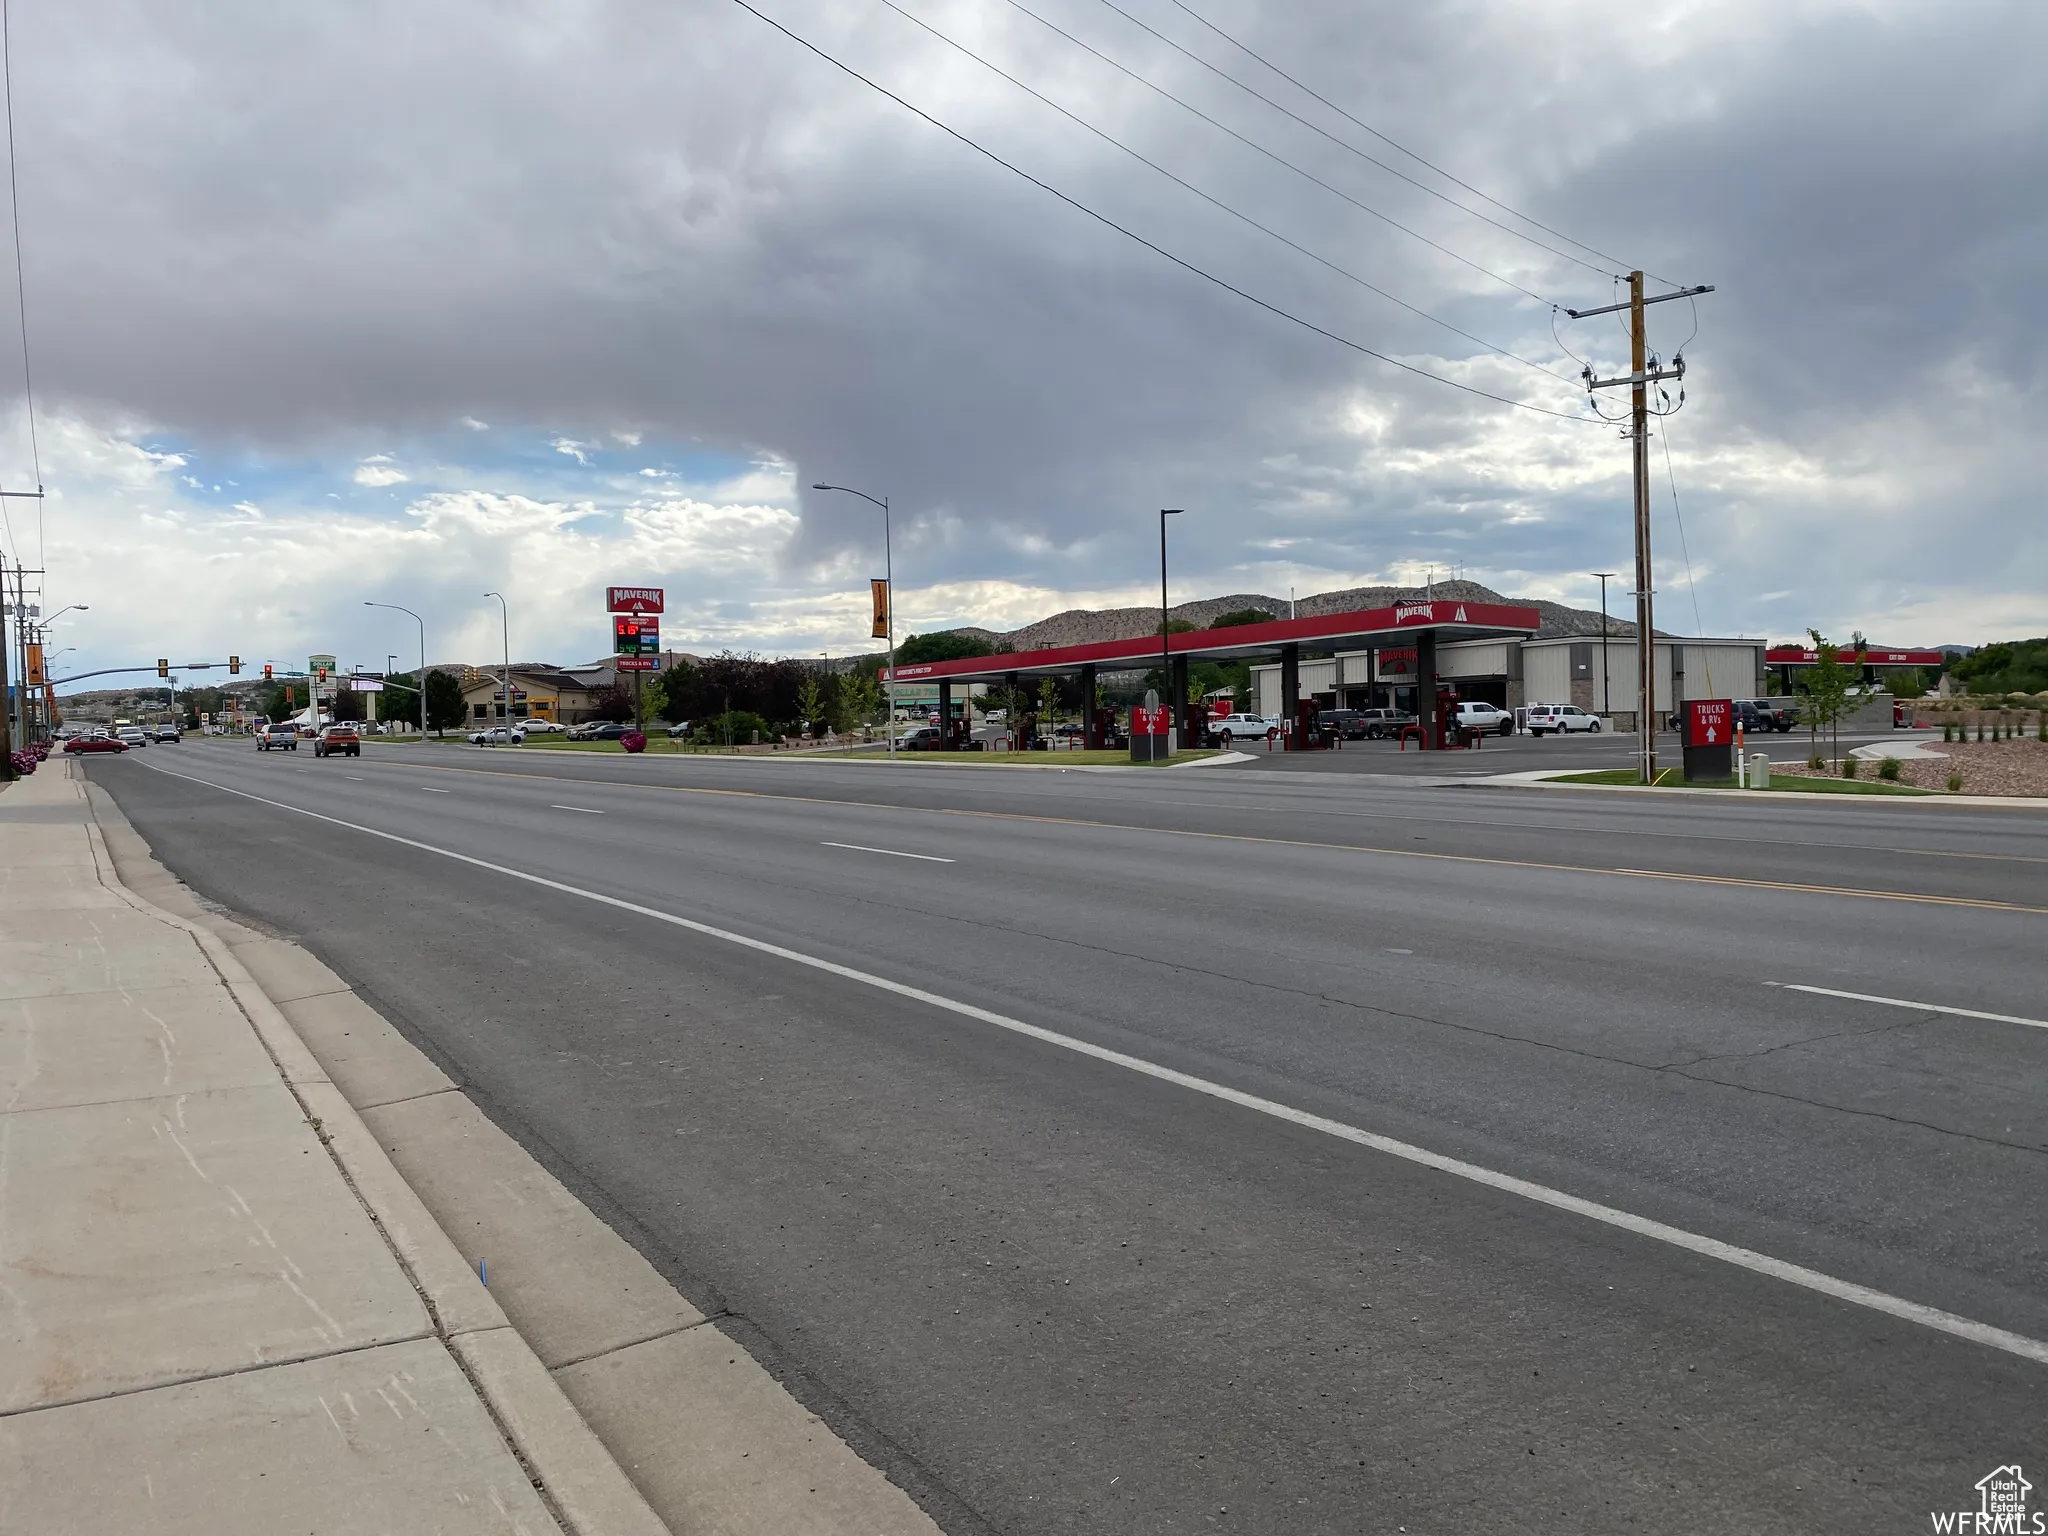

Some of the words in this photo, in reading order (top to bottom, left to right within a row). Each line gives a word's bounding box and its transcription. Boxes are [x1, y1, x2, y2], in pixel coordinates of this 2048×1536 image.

[614, 590, 660, 606] MAVERIK
[1396, 604, 1432, 624] MAVERIK
[1380, 648, 1418, 667] MAVERIK
[1697, 704, 1725, 714] TRUCKS
[1701, 715, 1707, 725] &
[1708, 715, 1721, 724] RVs
